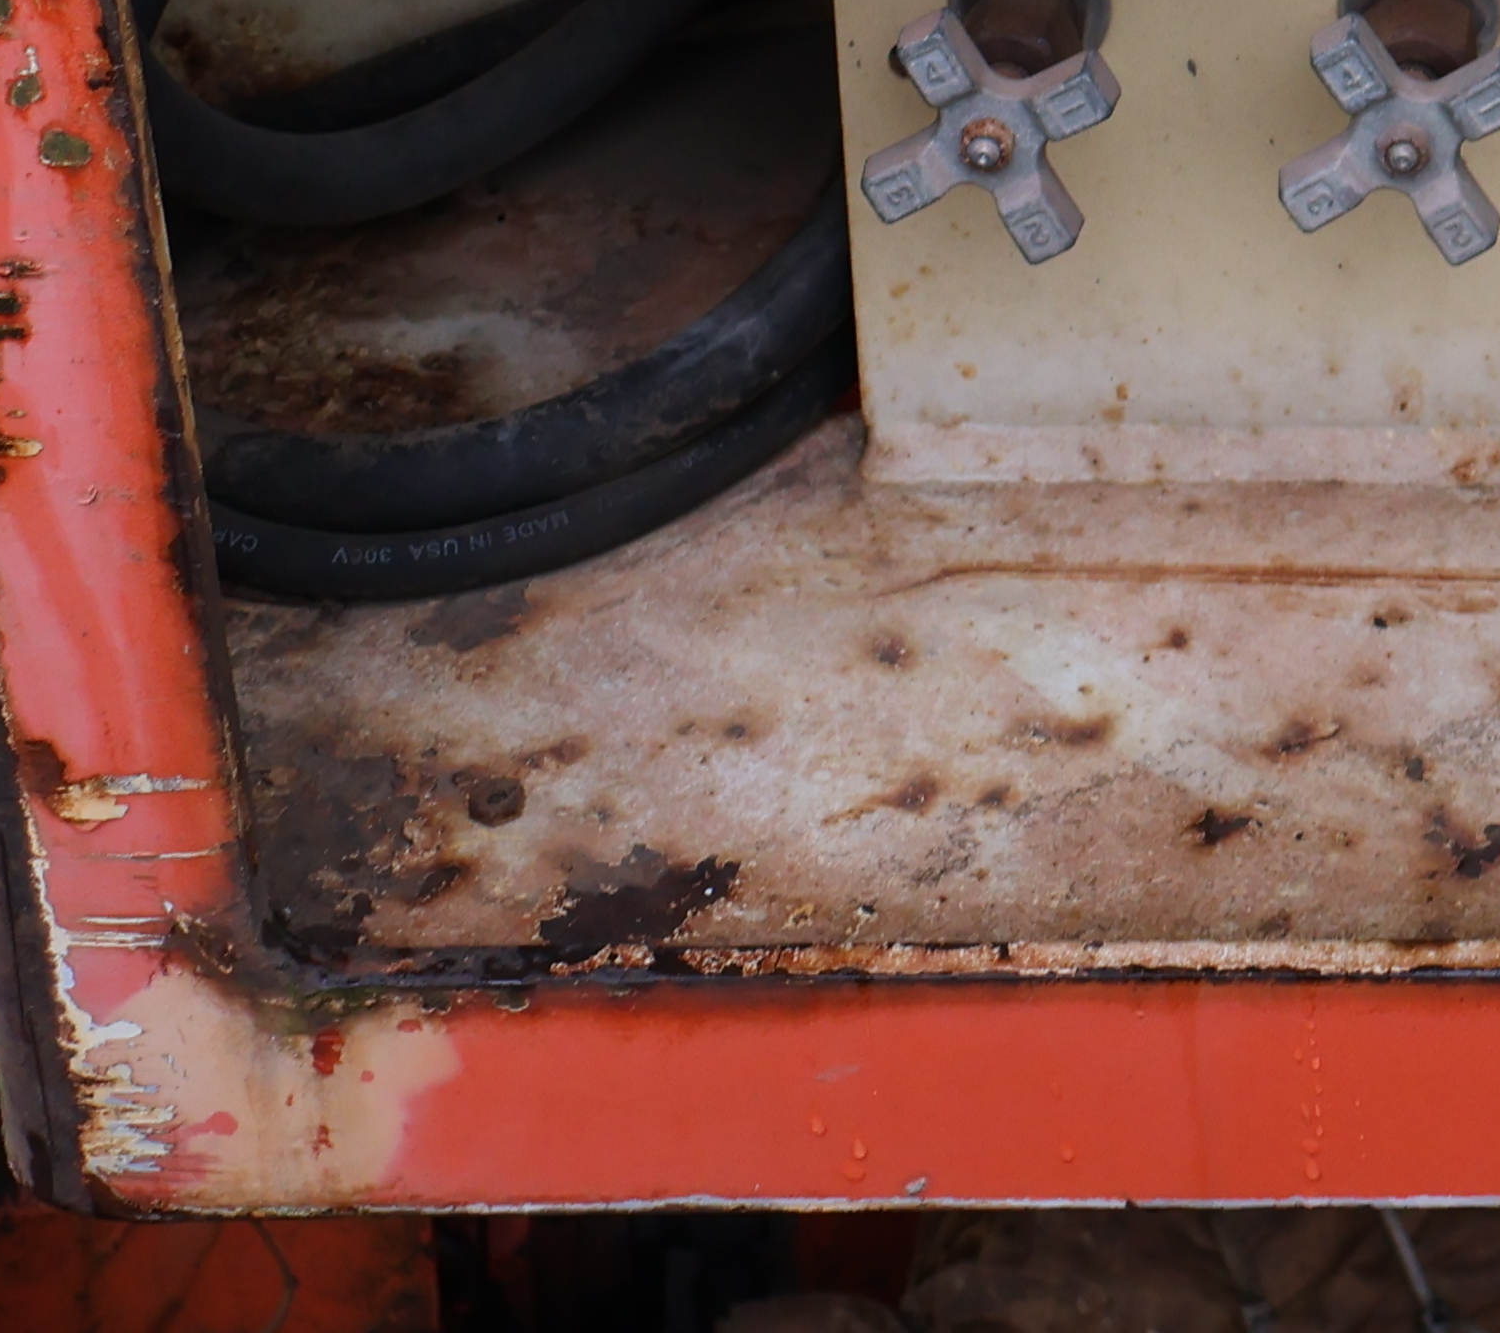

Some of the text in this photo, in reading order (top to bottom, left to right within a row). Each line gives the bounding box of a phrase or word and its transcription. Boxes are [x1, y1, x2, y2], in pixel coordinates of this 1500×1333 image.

[503, 508, 569, 542] MADE
[408, 537, 459, 562] USA
[469, 530, 493, 552] IN
